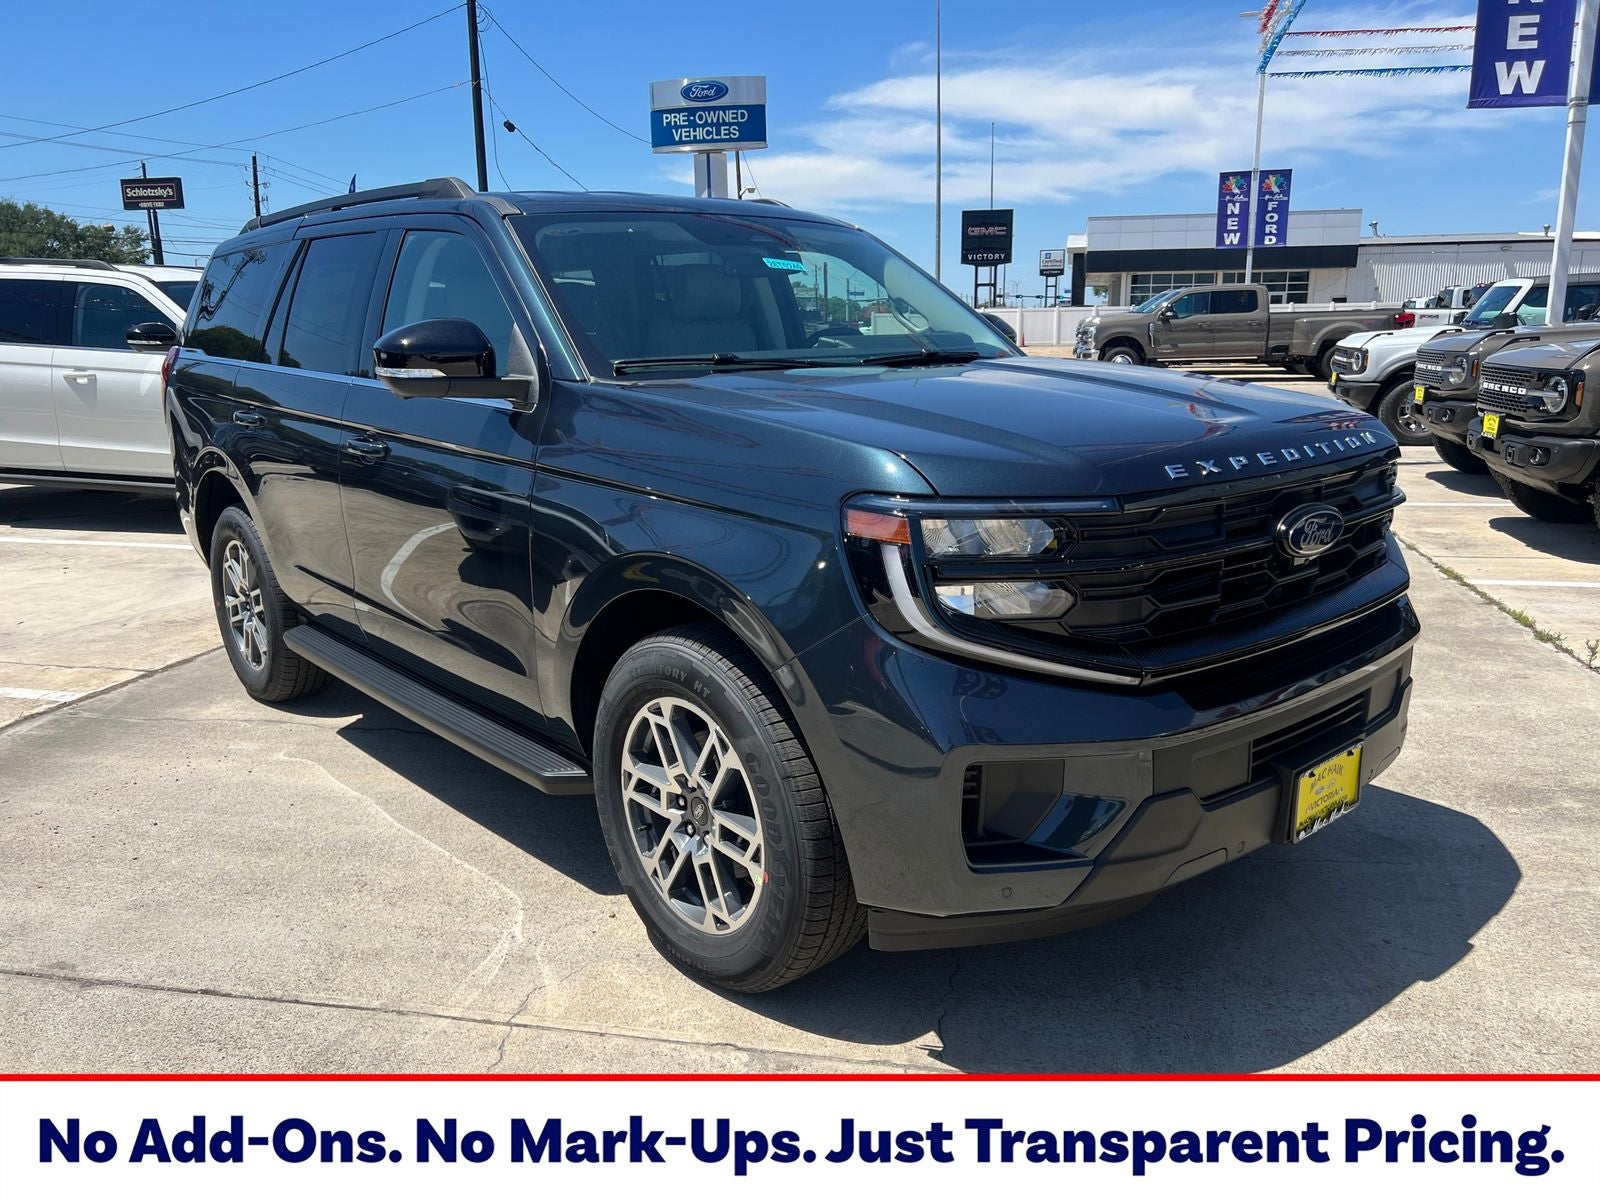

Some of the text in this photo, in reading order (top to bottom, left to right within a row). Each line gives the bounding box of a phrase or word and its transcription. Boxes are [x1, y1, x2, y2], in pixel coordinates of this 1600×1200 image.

[1494, 0, 1546, 95] EW
[689, 84, 717, 98] Ford
[663, 109, 748, 127] PRE-OWNED
[672, 126, 740, 141] VEHICLES
[126, 186, 173, 198] Schlotzsky's
[967, 226, 1007, 236] GMC
[1223, 202, 1241, 245] NEW
[1264, 201, 1279, 245] FORD
[1164, 431, 1378, 480] EXPEDITION
[1300, 516, 1336, 548] Ford
